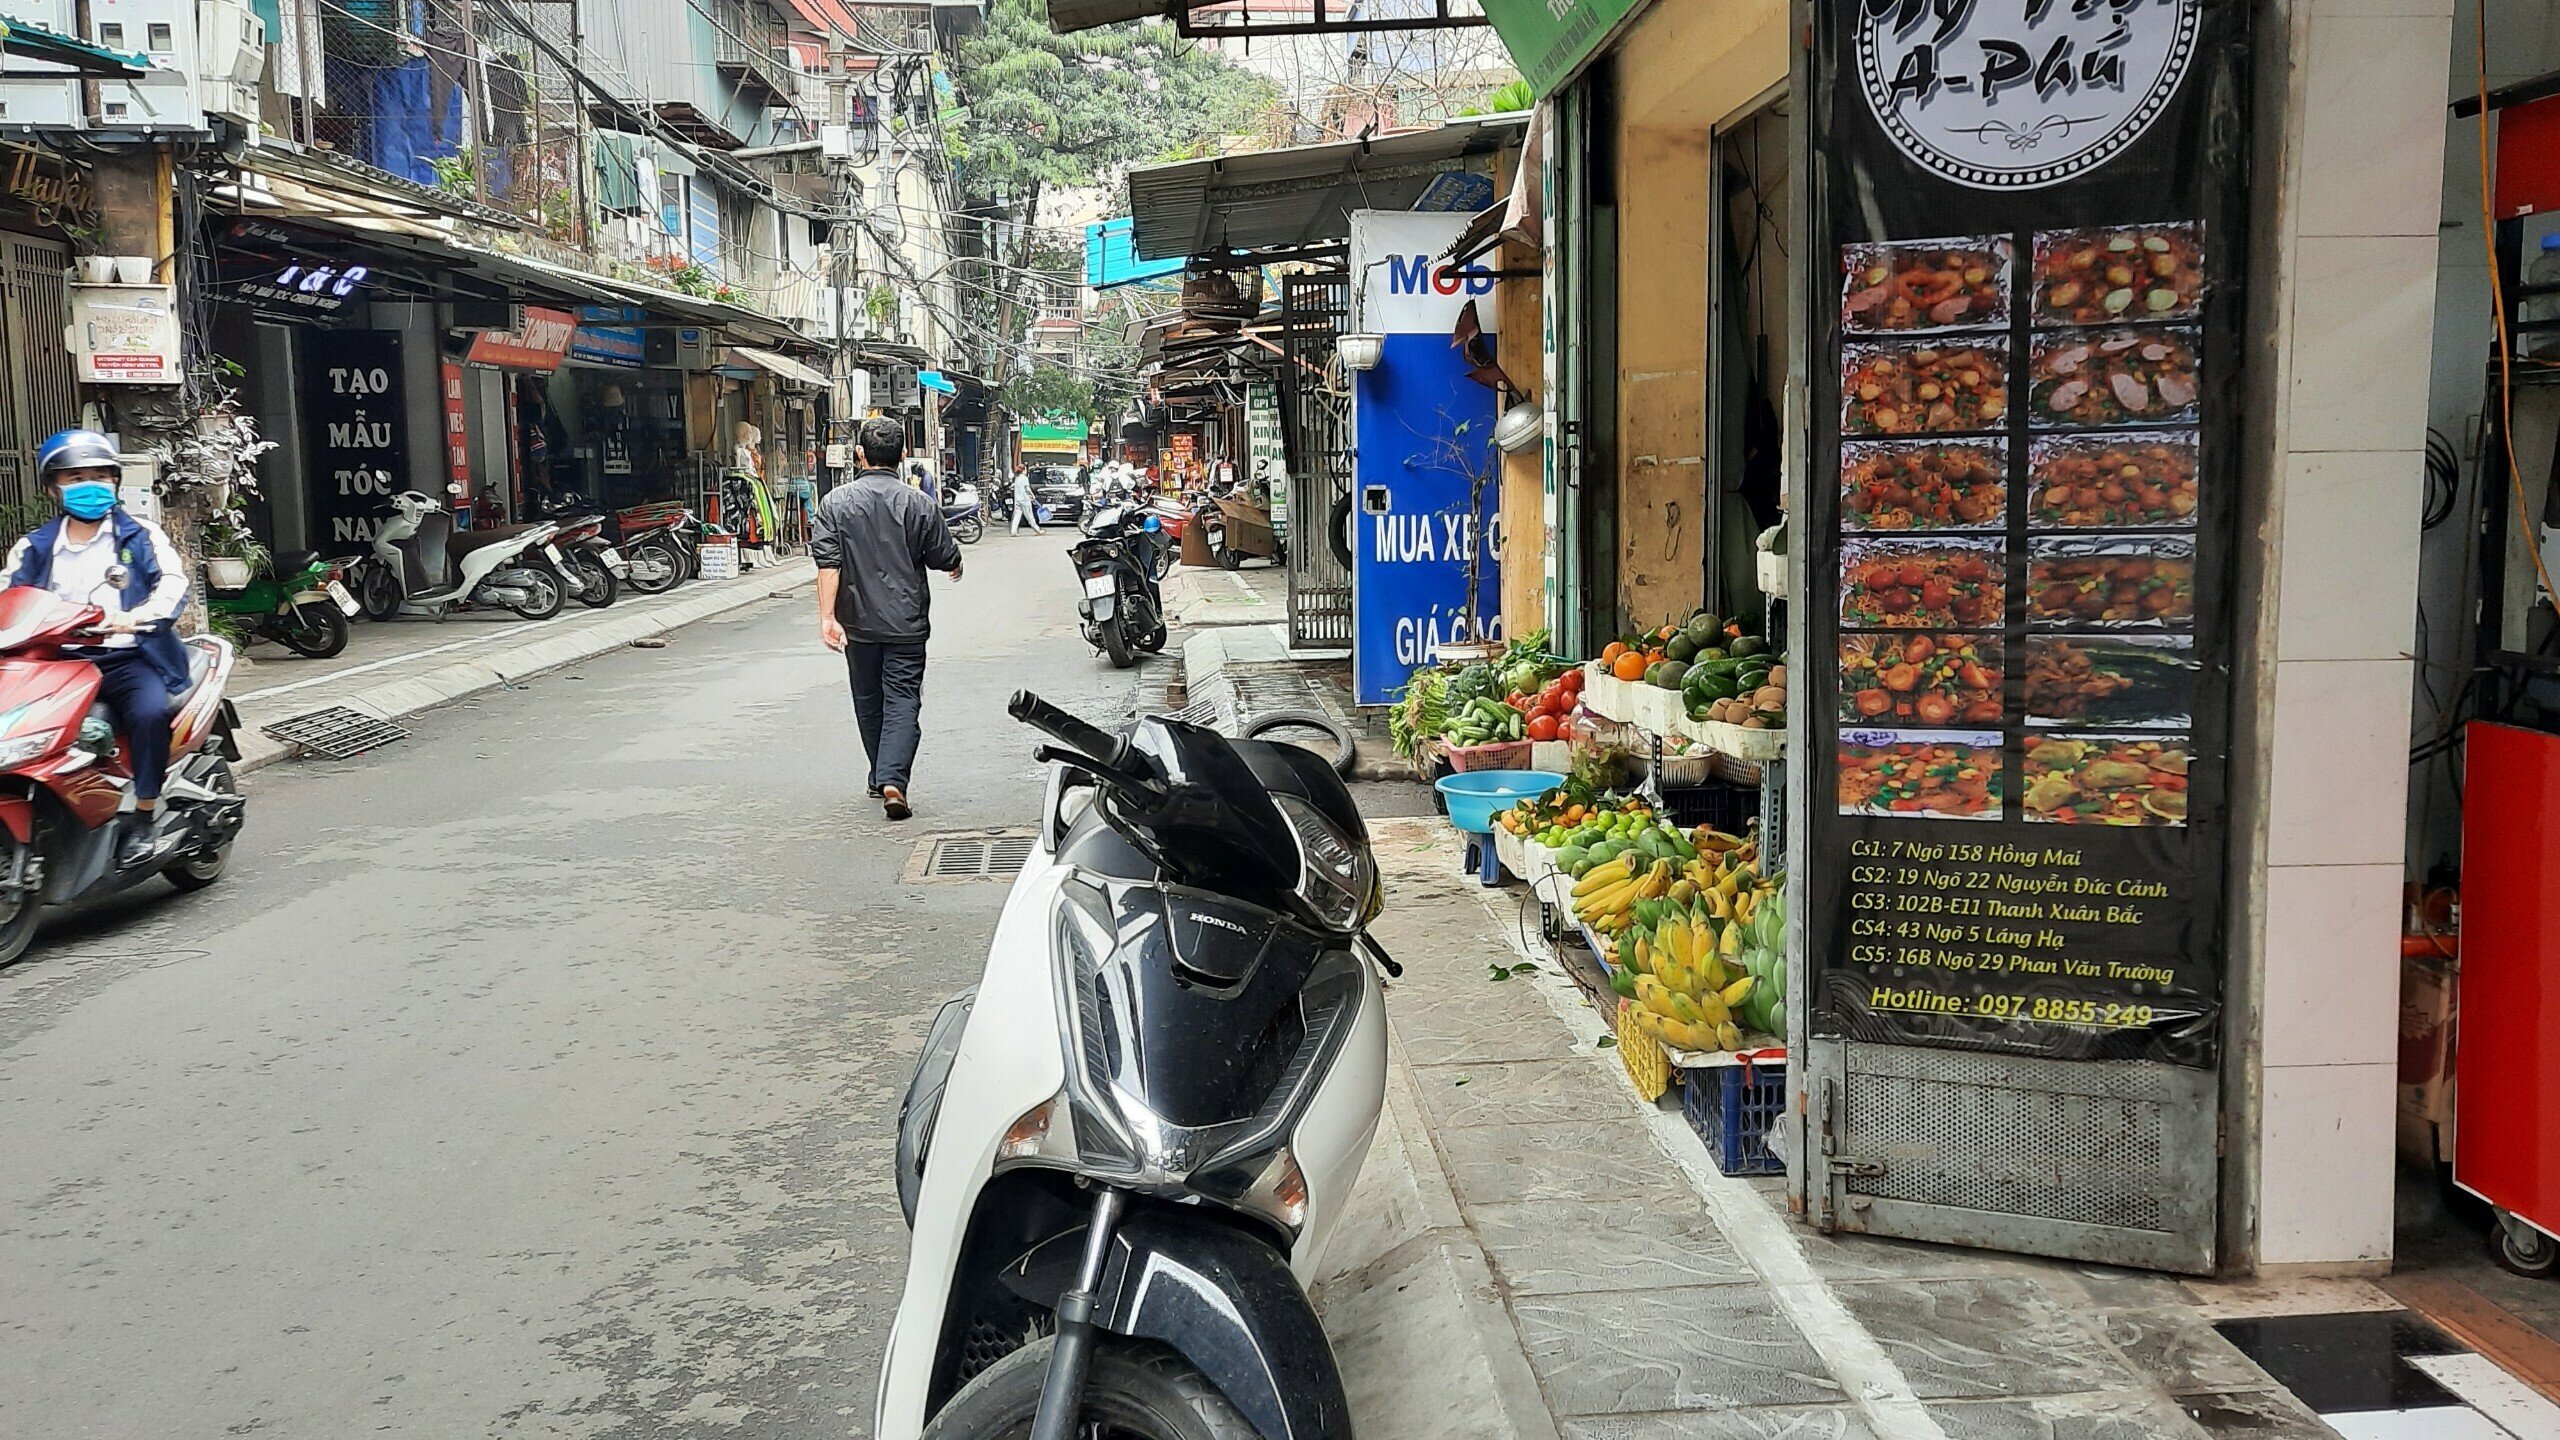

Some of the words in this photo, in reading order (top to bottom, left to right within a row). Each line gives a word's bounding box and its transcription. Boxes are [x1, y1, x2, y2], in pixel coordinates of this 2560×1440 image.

[329, 367, 390, 401] TẠO
[328, 409, 392, 449] MẪU
[334, 463, 392, 496] TÓC
[1375, 513, 1436, 563] MUA
[1395, 603, 1441, 666] GIÁ
[1891, 841, 1904, 859] 7
[1906, 842, 1945, 863] Ngõ
[1948, 844, 1984, 862] 158
[1988, 842, 2039, 868] Hồng
[2043, 848, 2083, 867] Mai
[1851, 866, 1892, 884] CS2:
[1896, 868, 1919, 885] 19
[1923, 869, 1963, 890] Ngõ
[1965, 871, 1991, 889] 22
[1996, 873, 2069, 895] Nguyễn
[2073, 876, 2112, 896] Đức
[2116, 878, 2170, 898] Cảnh
[1189, 912, 1249, 936] HONDA
[1851, 892, 1892, 911] CS3:
[1896, 894, 1981, 916] 102B-E11
[1988, 899, 2044, 919] Thanh
[2050, 902, 2102, 922] Xuân
[2106, 904, 2144, 925] Bắc
[1851, 919, 1892, 938] CS4:
[1896, 921, 1921, 939] 43
[1925, 922, 1965, 944] Ngõ
[1967, 925, 1981, 943] 5
[1985, 926, 2033, 949] Láng
[2037, 928, 2066, 951] Hạ
[1851, 945, 1892, 964] CS5:
[1896, 947, 1932, 966] 16B
[1936, 949, 1976, 971] Ngõ
[1978, 952, 2005, 971] 29
[2009, 954, 2058, 974] Phan
[2063, 958, 2102, 977] Văn
[2107, 961, 2176, 986] Trường
[1870, 986, 1971, 1013] Hotline:
[1977, 993, 2027, 1018] 097
[2032, 996, 2098, 1023] 8855
[2103, 1002, 2154, 1027] 249
